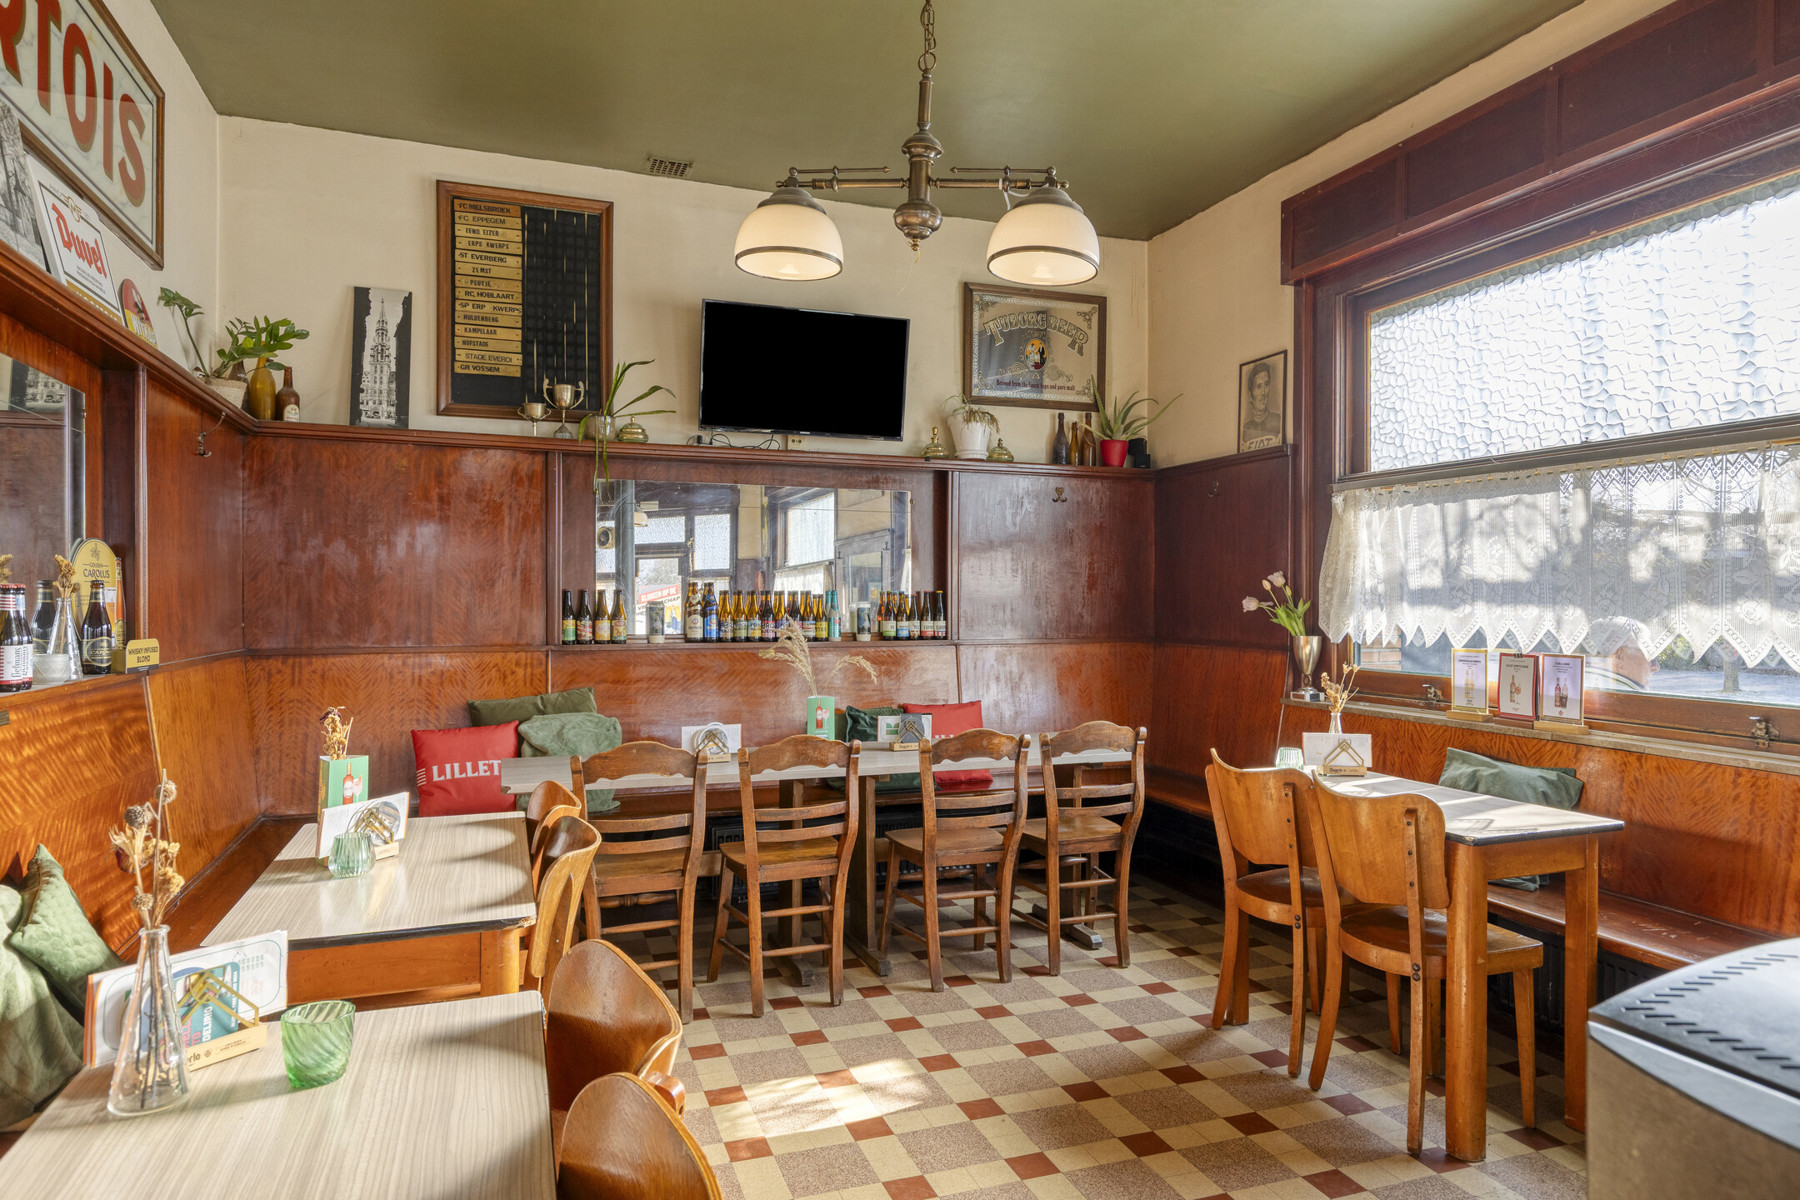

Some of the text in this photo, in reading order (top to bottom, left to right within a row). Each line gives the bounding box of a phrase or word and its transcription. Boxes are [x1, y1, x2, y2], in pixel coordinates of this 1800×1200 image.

[472, 216, 506, 224] EPPEGEM
[52, 202, 107, 279] Duvel
[471, 253, 507, 263] EVERBERG
[493, 305, 522, 314] KWERPS
[464, 327, 497, 335] KAMPELAAR
[983, 311, 1089, 357] TUBORG BEER
[465, 352, 486, 361] STADE
[472, 365, 500, 373] VOSSEM
[1248, 438, 1272, 450] FIAT
[83, 569, 110, 580] CAROLUS
[432, 760, 502, 782] LILLET
[202, 1006, 213, 1042] DELIRIO
